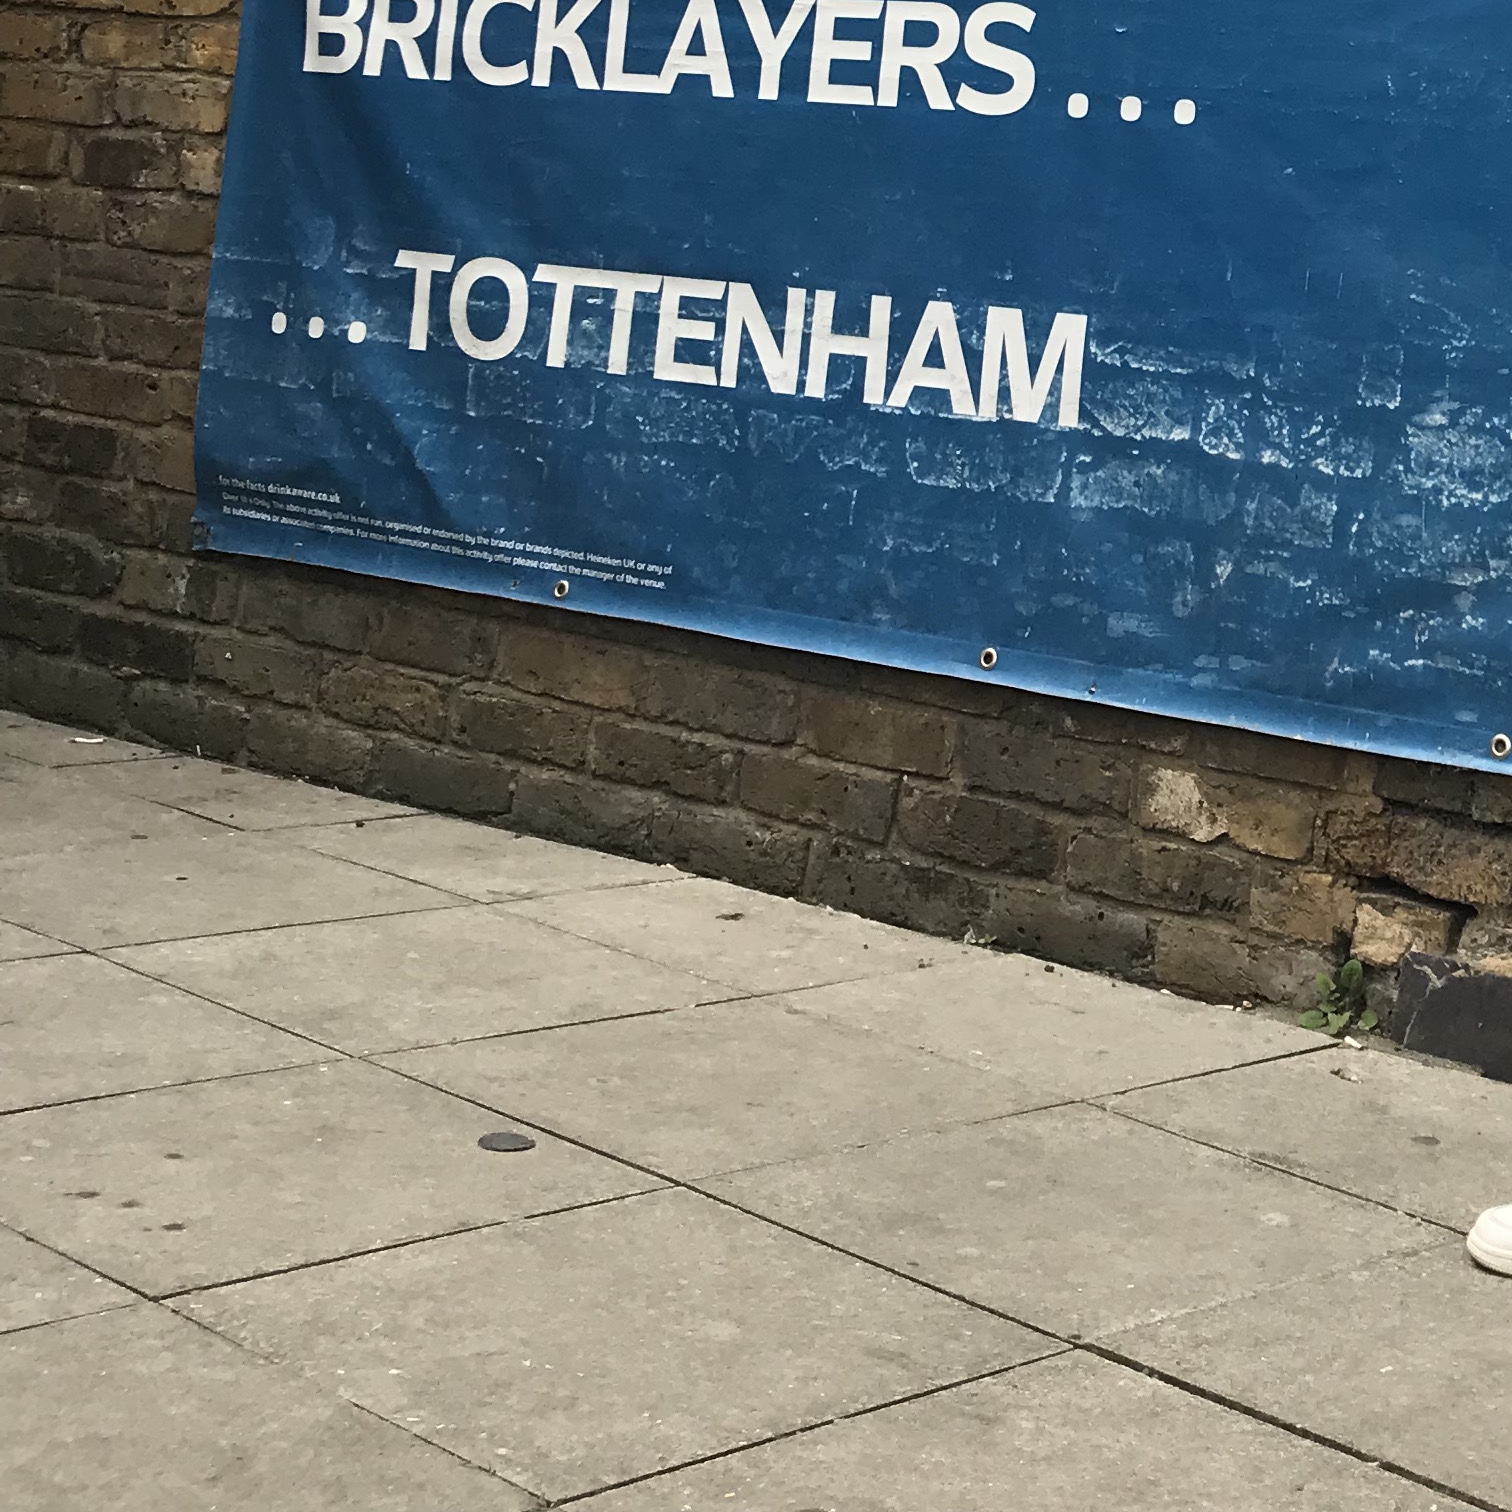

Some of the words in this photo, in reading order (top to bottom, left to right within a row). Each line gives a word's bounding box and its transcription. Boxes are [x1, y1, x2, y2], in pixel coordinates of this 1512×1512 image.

[267, 483, 341, 504] drinkaware.co.uk
[232, 507, 272, 522] subsidiaries
[280, 516, 315, 530] associated
[356, 528, 369, 538] For
[369, 532, 388, 542] more
[388, 534, 430, 549] information
[430, 543, 450, 553] about
[451, 546, 465, 556] this
[512, 557, 539, 569] please
[538, 562, 568, 573] contact
[568, 565, 582, 575] the
[582, 568, 615, 582] manager
[615, 572, 625, 582] of
[625, 574, 640, 584] the
[640, 579, 666, 590] venue.
[286, 503, 307, 514] above
[385, 521, 423, 534] organised
[423, 526, 432, 535] or
[432, 528, 464, 542] endorsed
[464, 534, 475, 545] by
[476, 535, 490, 546] the
[490, 538, 515, 549] brand
[515, 542, 525, 551] or
[525, 543, 552, 555] brands
[586, 552, 623, 567] Heineken
[622, 558, 636, 569] UK
[636, 561, 647, 571] or
[646, 564, 663, 576] any
[663, 565, 673, 575] of
